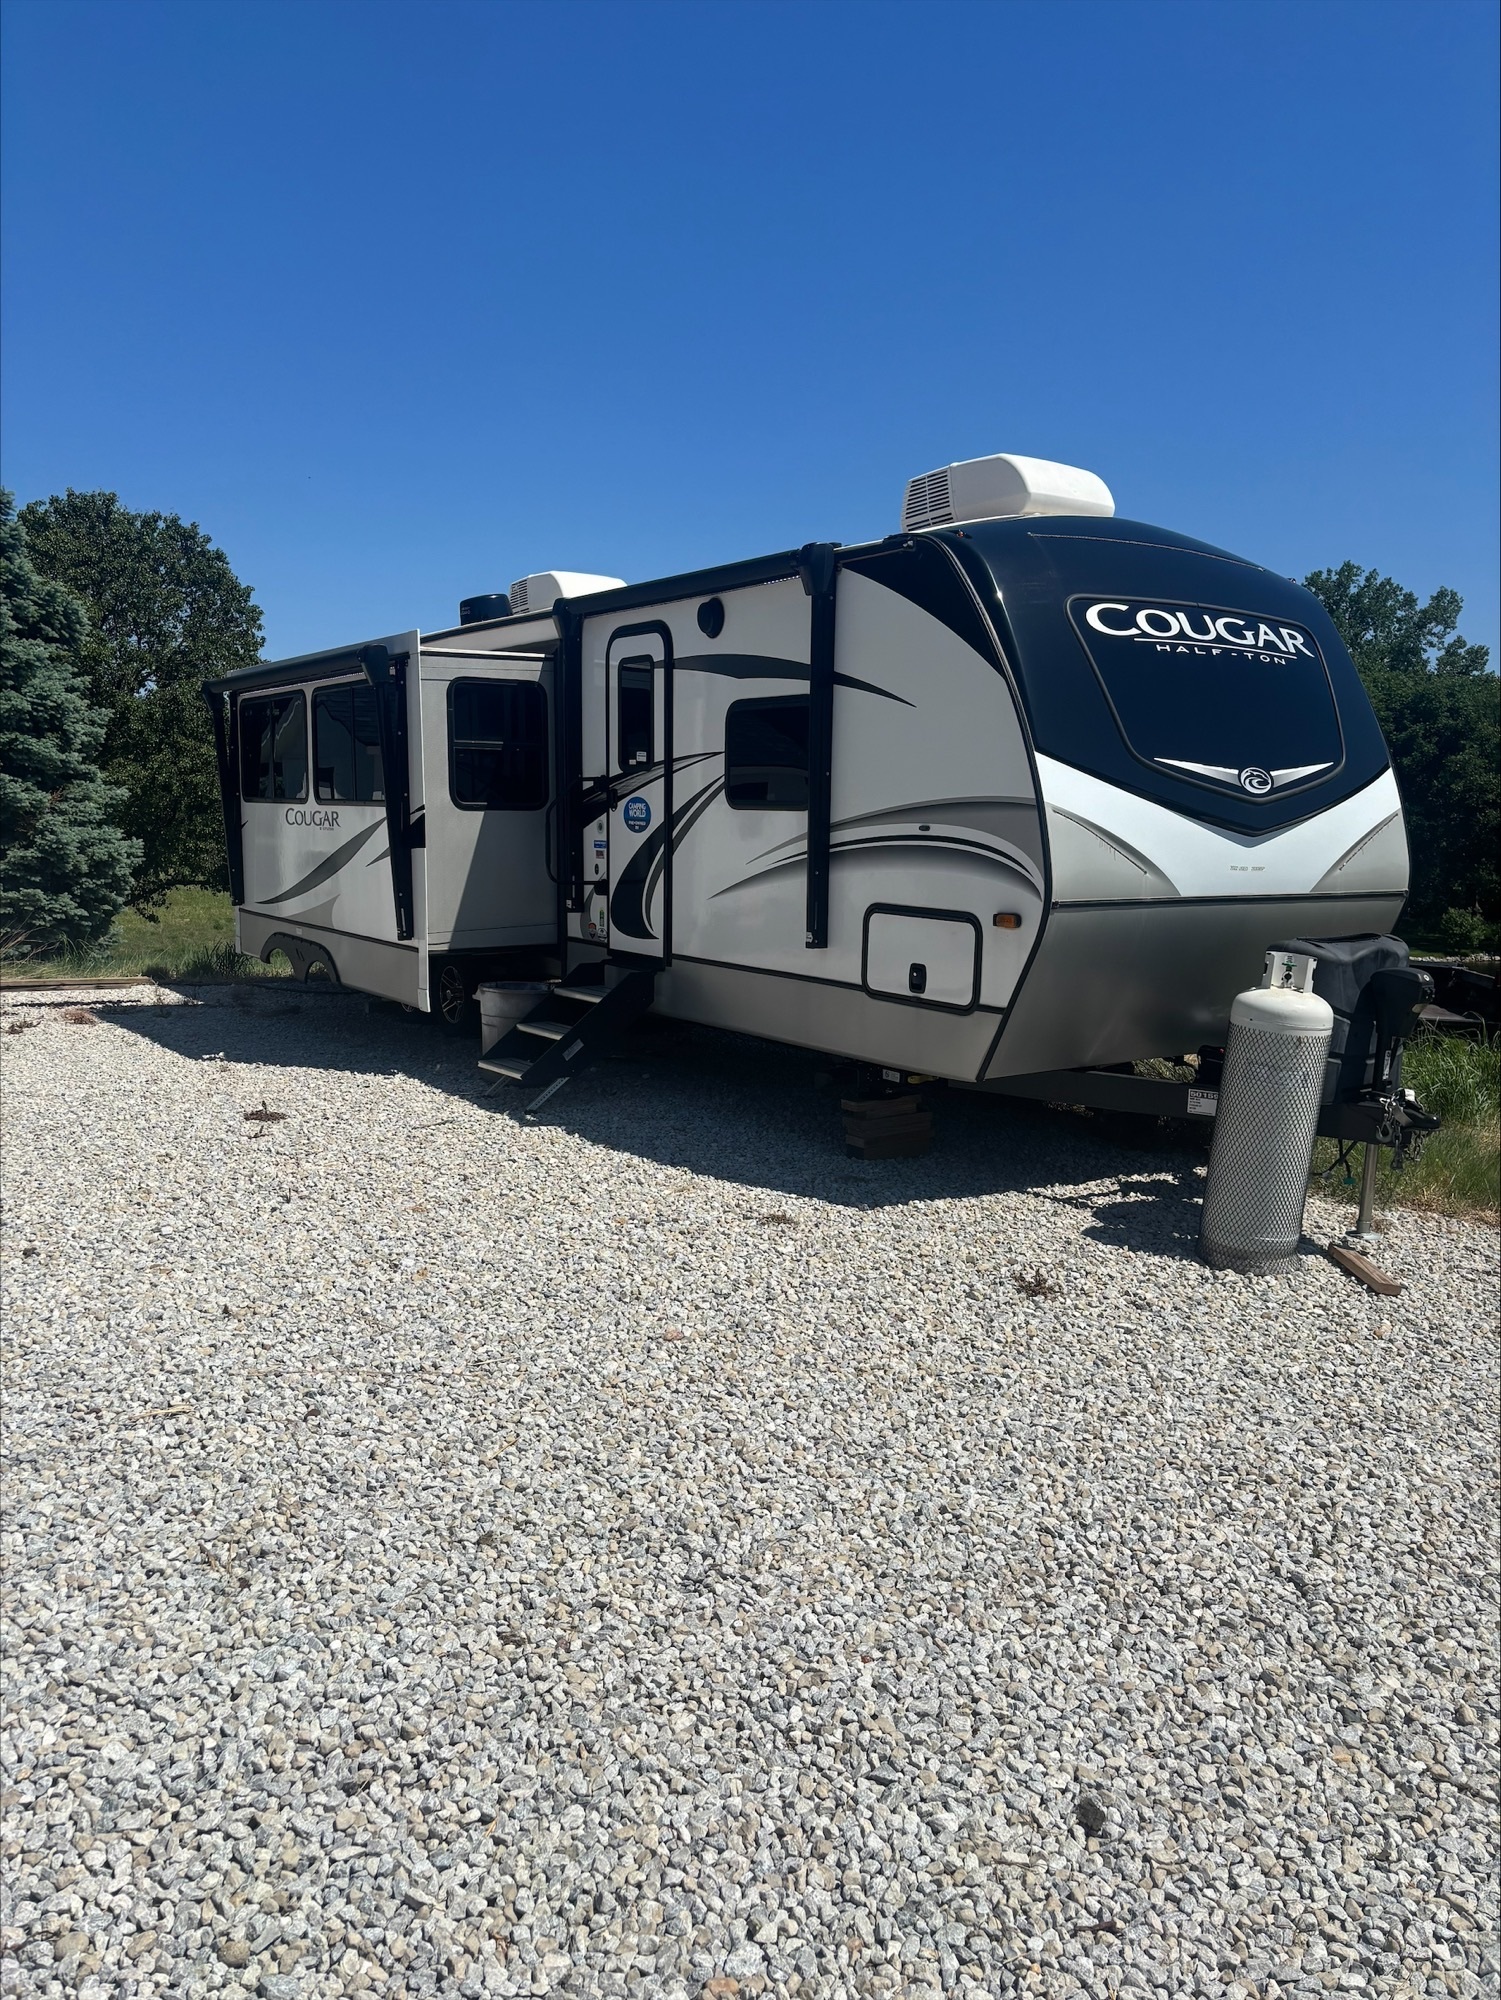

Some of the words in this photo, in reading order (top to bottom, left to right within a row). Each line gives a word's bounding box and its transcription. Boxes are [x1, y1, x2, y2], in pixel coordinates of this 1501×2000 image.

[1085, 603, 1315, 658] COUGAR
[285, 807, 341, 827] COUGAR
[628, 809, 646, 817] WORLD
